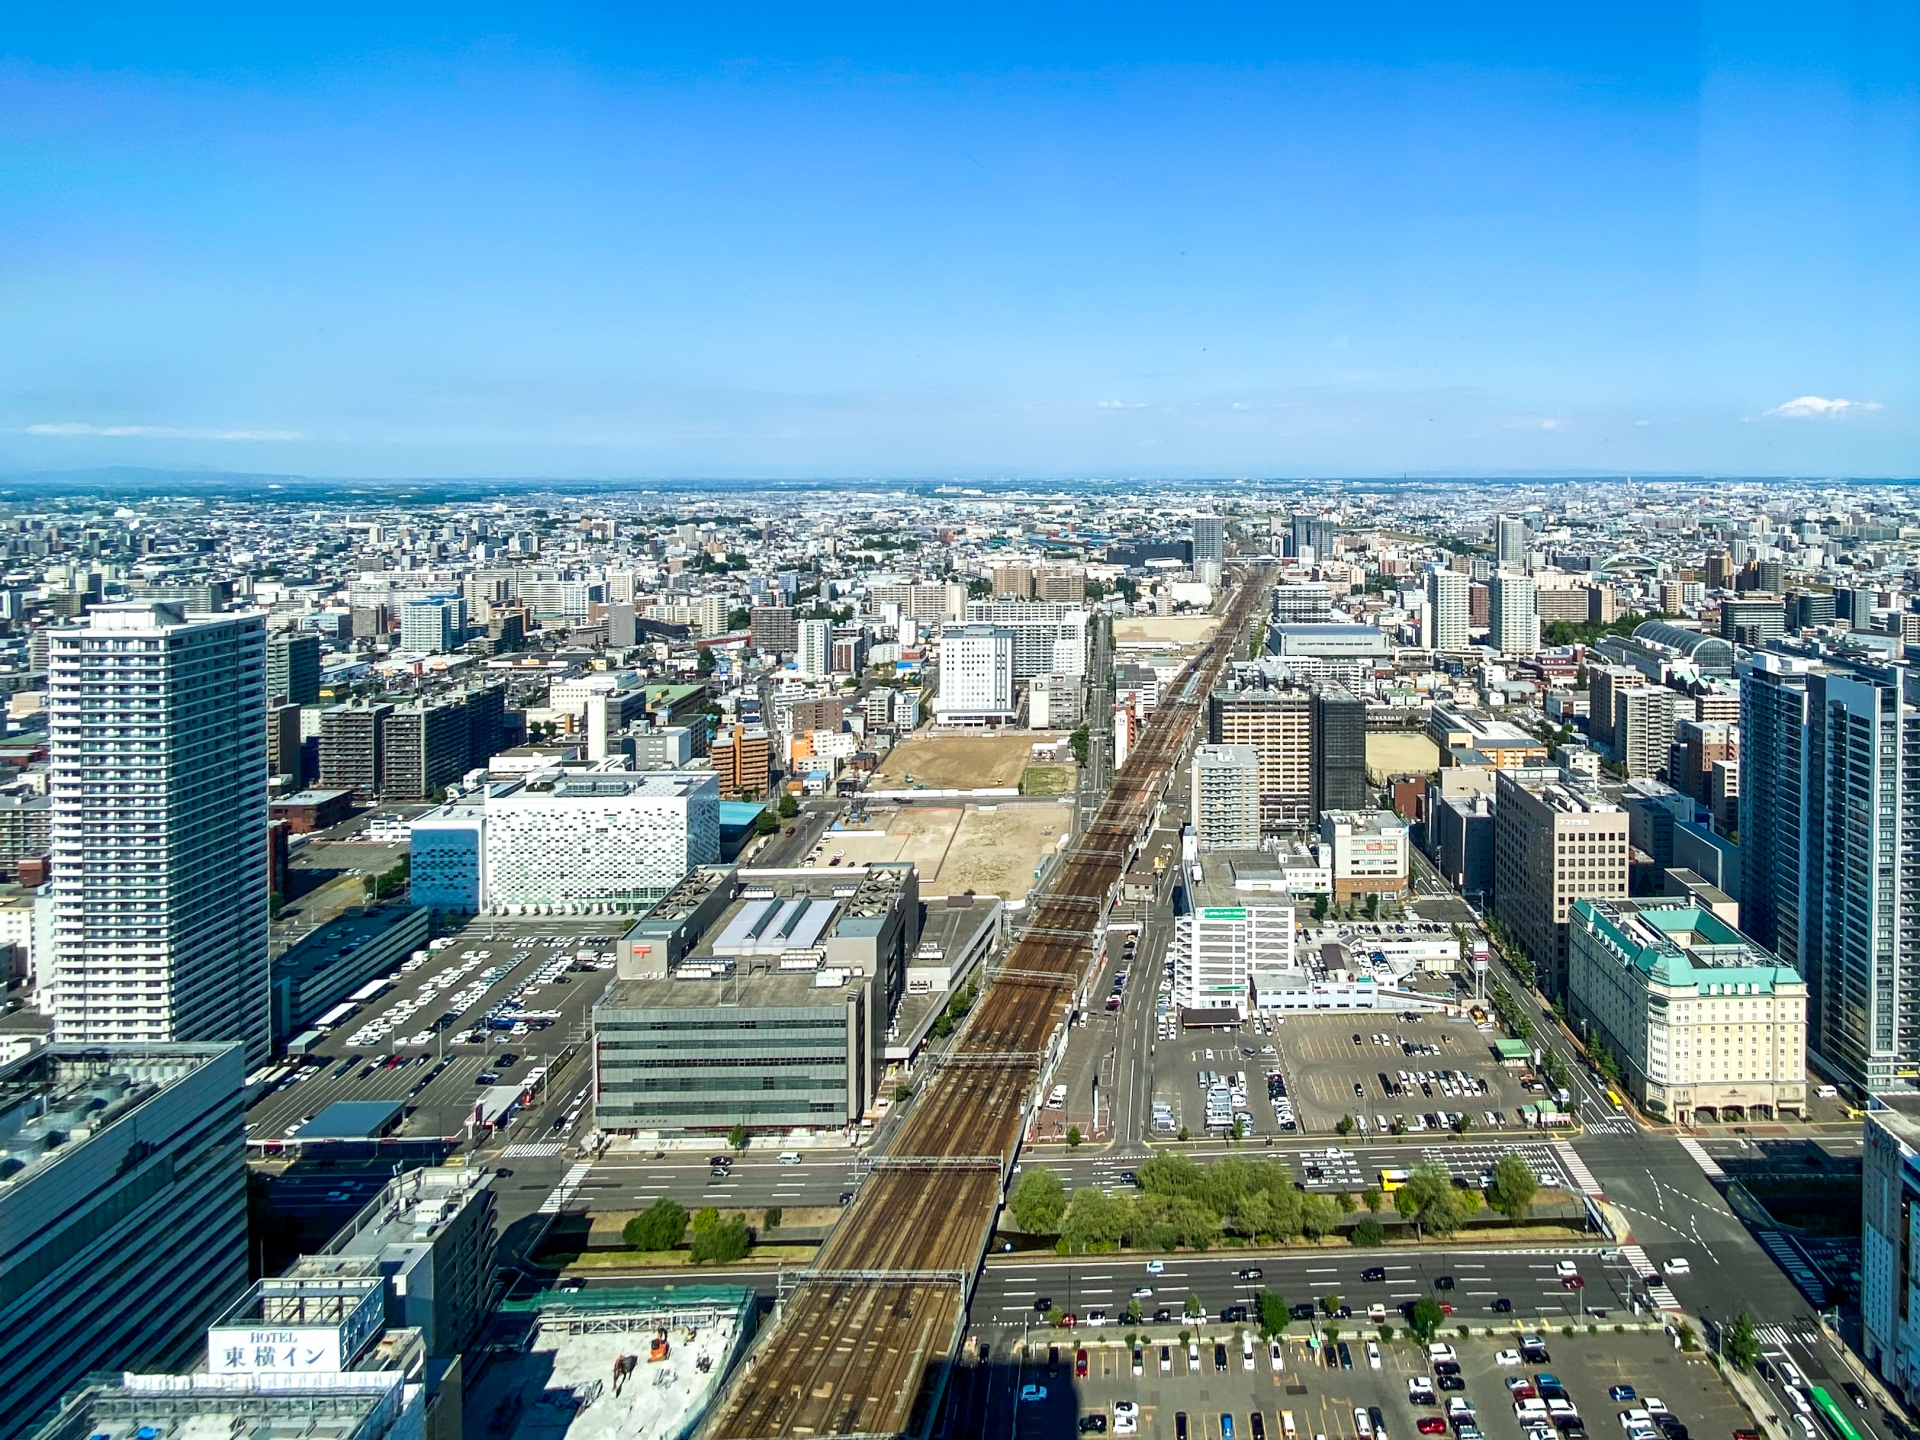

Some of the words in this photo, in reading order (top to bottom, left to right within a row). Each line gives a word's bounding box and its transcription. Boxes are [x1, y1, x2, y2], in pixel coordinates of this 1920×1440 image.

[250, 1332, 298, 1344] HOTEL
[223, 1345, 326, 1368] 東横イン
